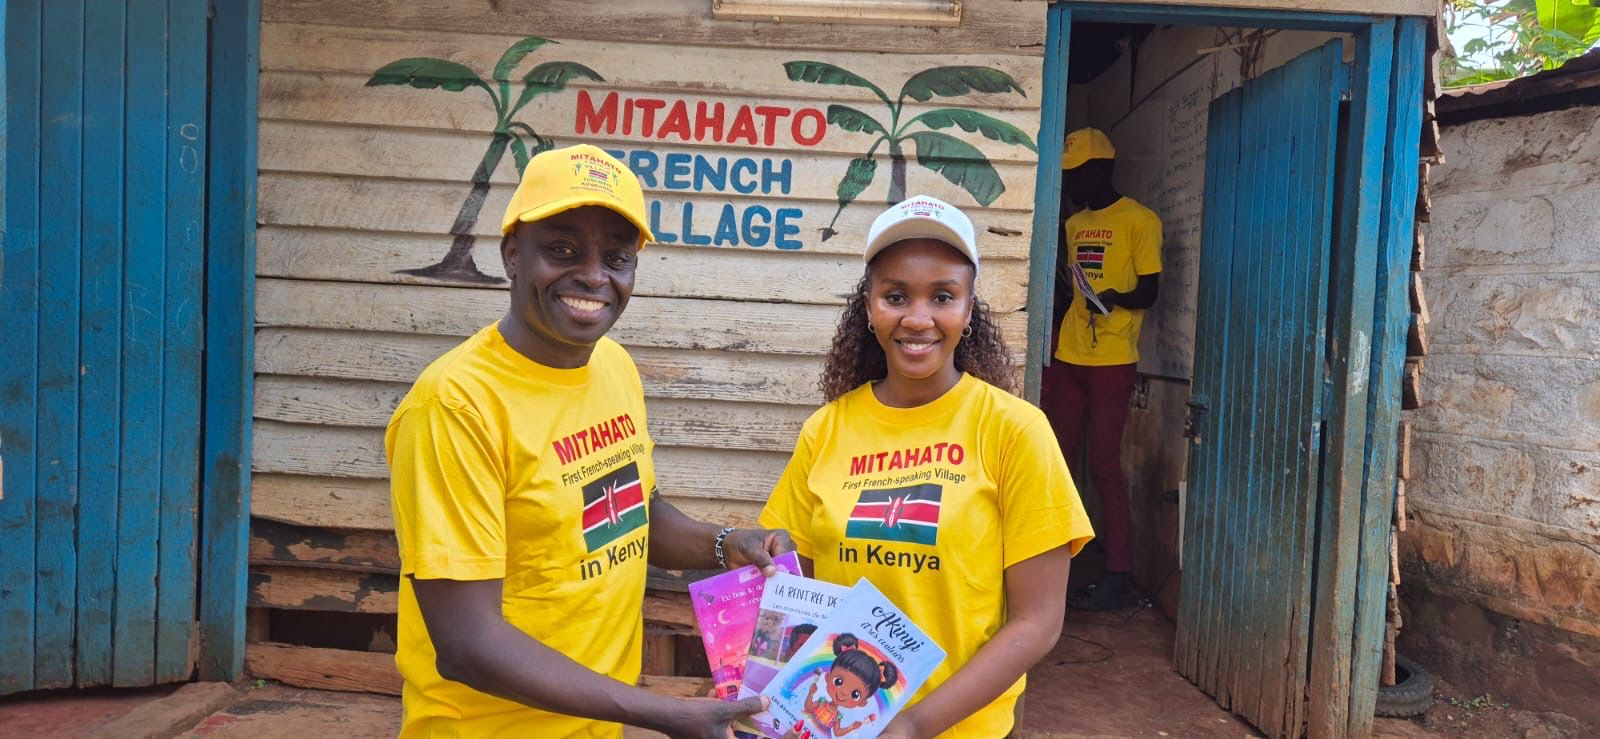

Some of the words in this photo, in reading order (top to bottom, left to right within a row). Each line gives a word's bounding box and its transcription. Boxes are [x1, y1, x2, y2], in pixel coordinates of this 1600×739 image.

[575, 89, 828, 147] MITAHATO
[607, 150, 793, 196] RENCH
[650, 200, 804, 251] LLAGE
[552, 413, 636, 466] MITAHATO
[849, 441, 964, 477] MITAHATO
[562, 470, 584, 487] First
[583, 448, 632, 480] French-speaking
[842, 481, 862, 491] First
[863, 470, 931, 487] French-speaking
[934, 467, 966, 485] Village
[581, 558, 602, 581] in
[607, 535, 648, 569] Keny
[839, 542, 858, 563] in
[867, 544, 940, 574] Kenya
[775, 584, 785, 598] LA
[871, 606, 925, 652] Akinyi
